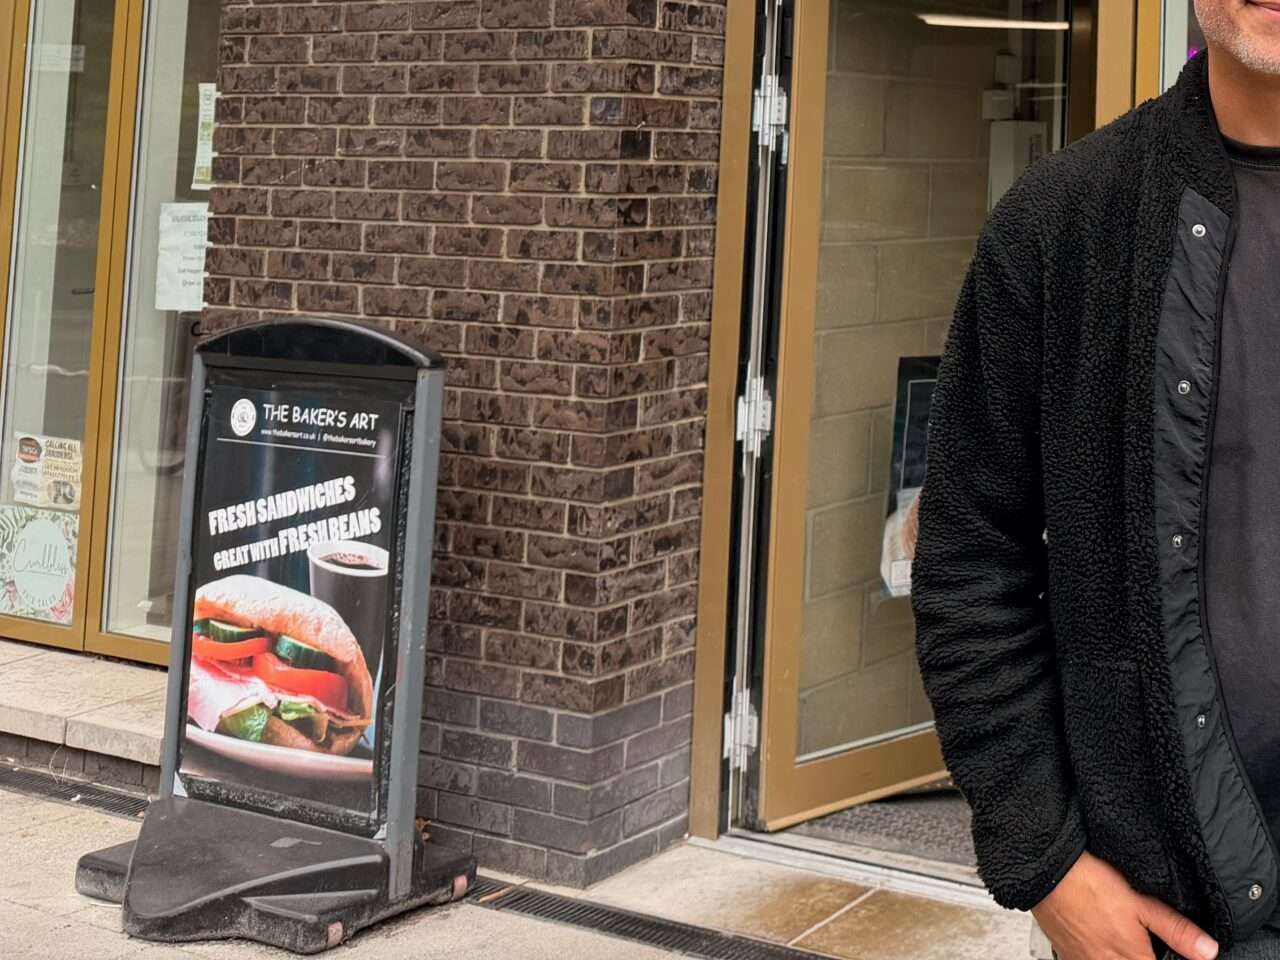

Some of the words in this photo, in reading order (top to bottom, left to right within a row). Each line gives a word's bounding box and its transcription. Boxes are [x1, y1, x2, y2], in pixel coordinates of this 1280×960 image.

[262, 403, 290, 422] THE
[292, 406, 347, 428] BAKER'S
[349, 412, 379, 431] ART
[208, 501, 256, 536] FRESH
[256, 475, 356, 523] SANDWICHES
[213, 544, 250, 571] GREAT
[250, 537, 279, 562] WITH
[278, 518, 330, 556] FRESH
[328, 507, 382, 541] BEANS
